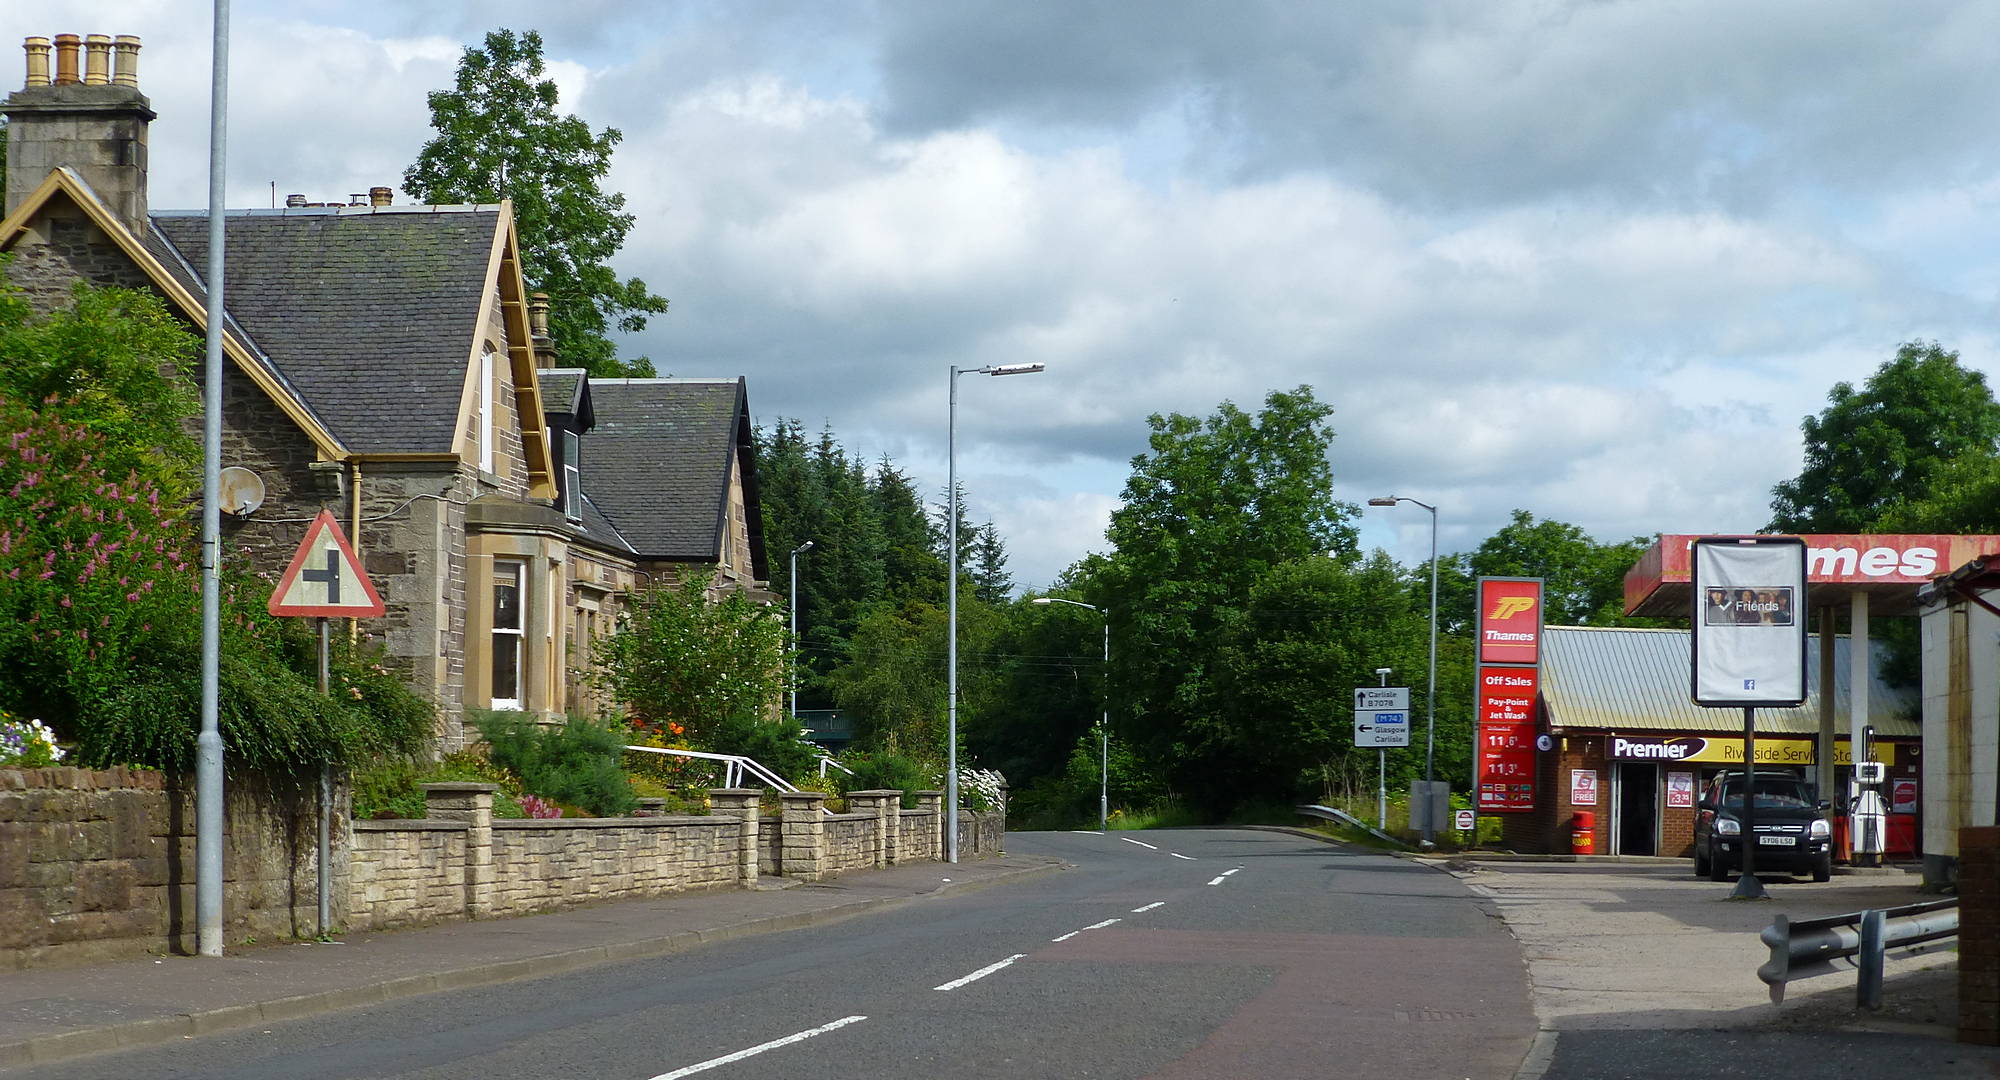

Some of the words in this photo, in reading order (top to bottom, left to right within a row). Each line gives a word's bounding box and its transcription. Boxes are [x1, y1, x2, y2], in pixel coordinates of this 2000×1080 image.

[1736, 600, 1779, 612] Friends
[1485, 630, 1535, 641] Thames
[1485, 676, 1504, 685] Off
[1505, 676, 1532, 686] Sales
[1488, 698, 1529, 707] Pay-Point
[1375, 726, 1406, 734] Glasgow
[1614, 738, 1688, 758] Premier
[1724, 745, 1780, 760] Rivside
[1783, 746, 1816, 761] Serv
[1575, 793, 1594, 801] FREE
